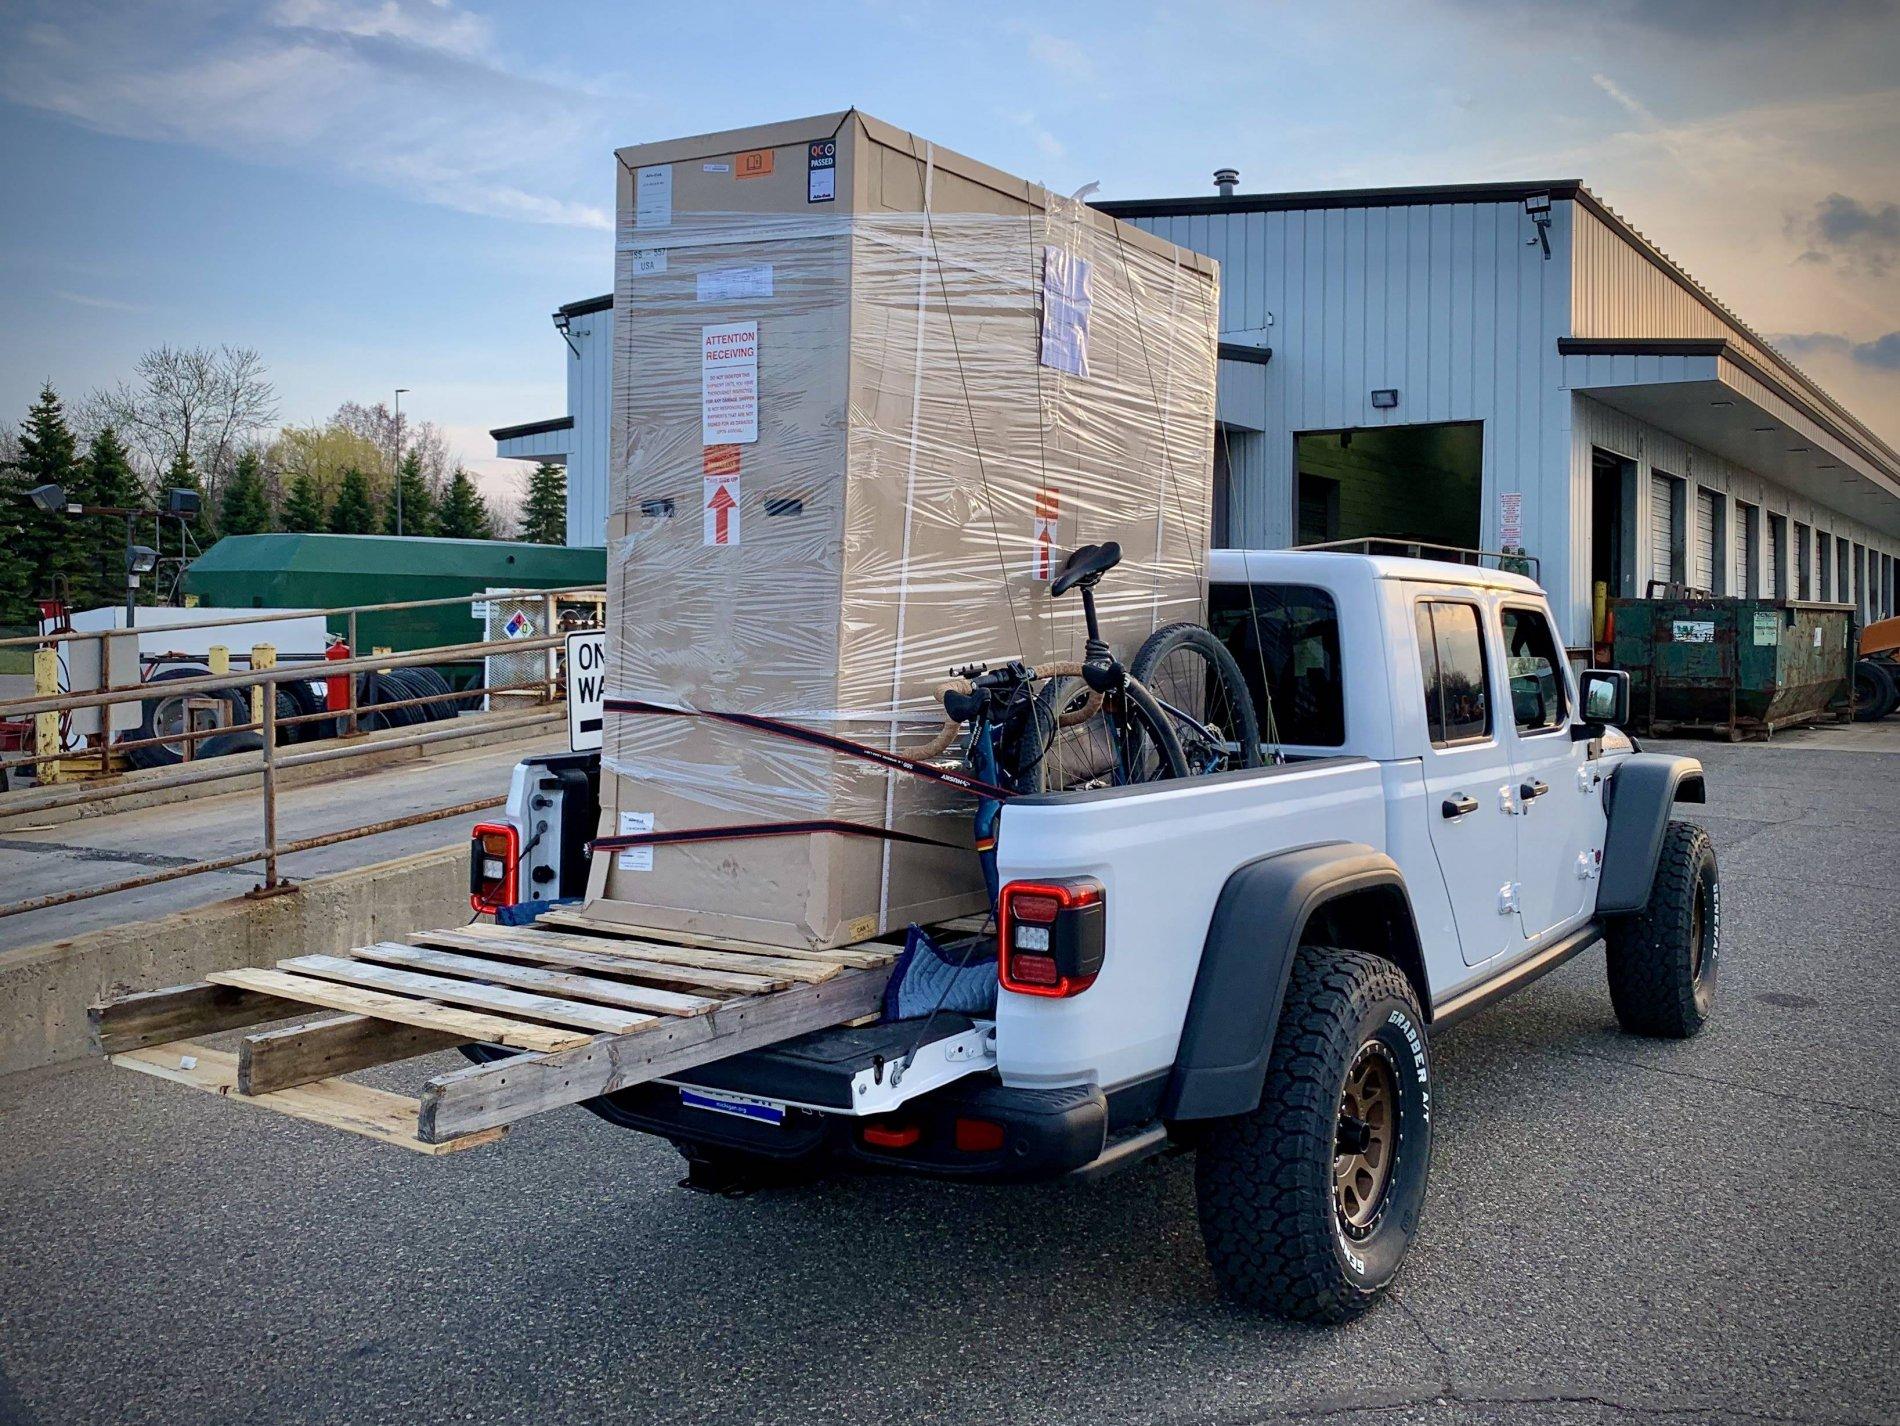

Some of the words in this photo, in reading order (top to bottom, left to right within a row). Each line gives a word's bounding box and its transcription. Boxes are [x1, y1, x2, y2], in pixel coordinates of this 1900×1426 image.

[811, 145, 824, 157] QC
[811, 157, 833, 167] PASSED
[640, 261, 655, 271] USA
[705, 331, 755, 346] ATTENTION
[706, 347, 754, 361] RECEIVING
[522, 623, 528, 634] 0
[579, 643, 606, 670] ON
[941, 774, 964, 786] HUSKY
[1712, 882, 1720, 960] GENERAL
[1387, 1009, 1427, 1084] GRABBER
[1421, 1091, 1431, 1123] A/T
[715, 1102, 747, 1114] michigan.org
